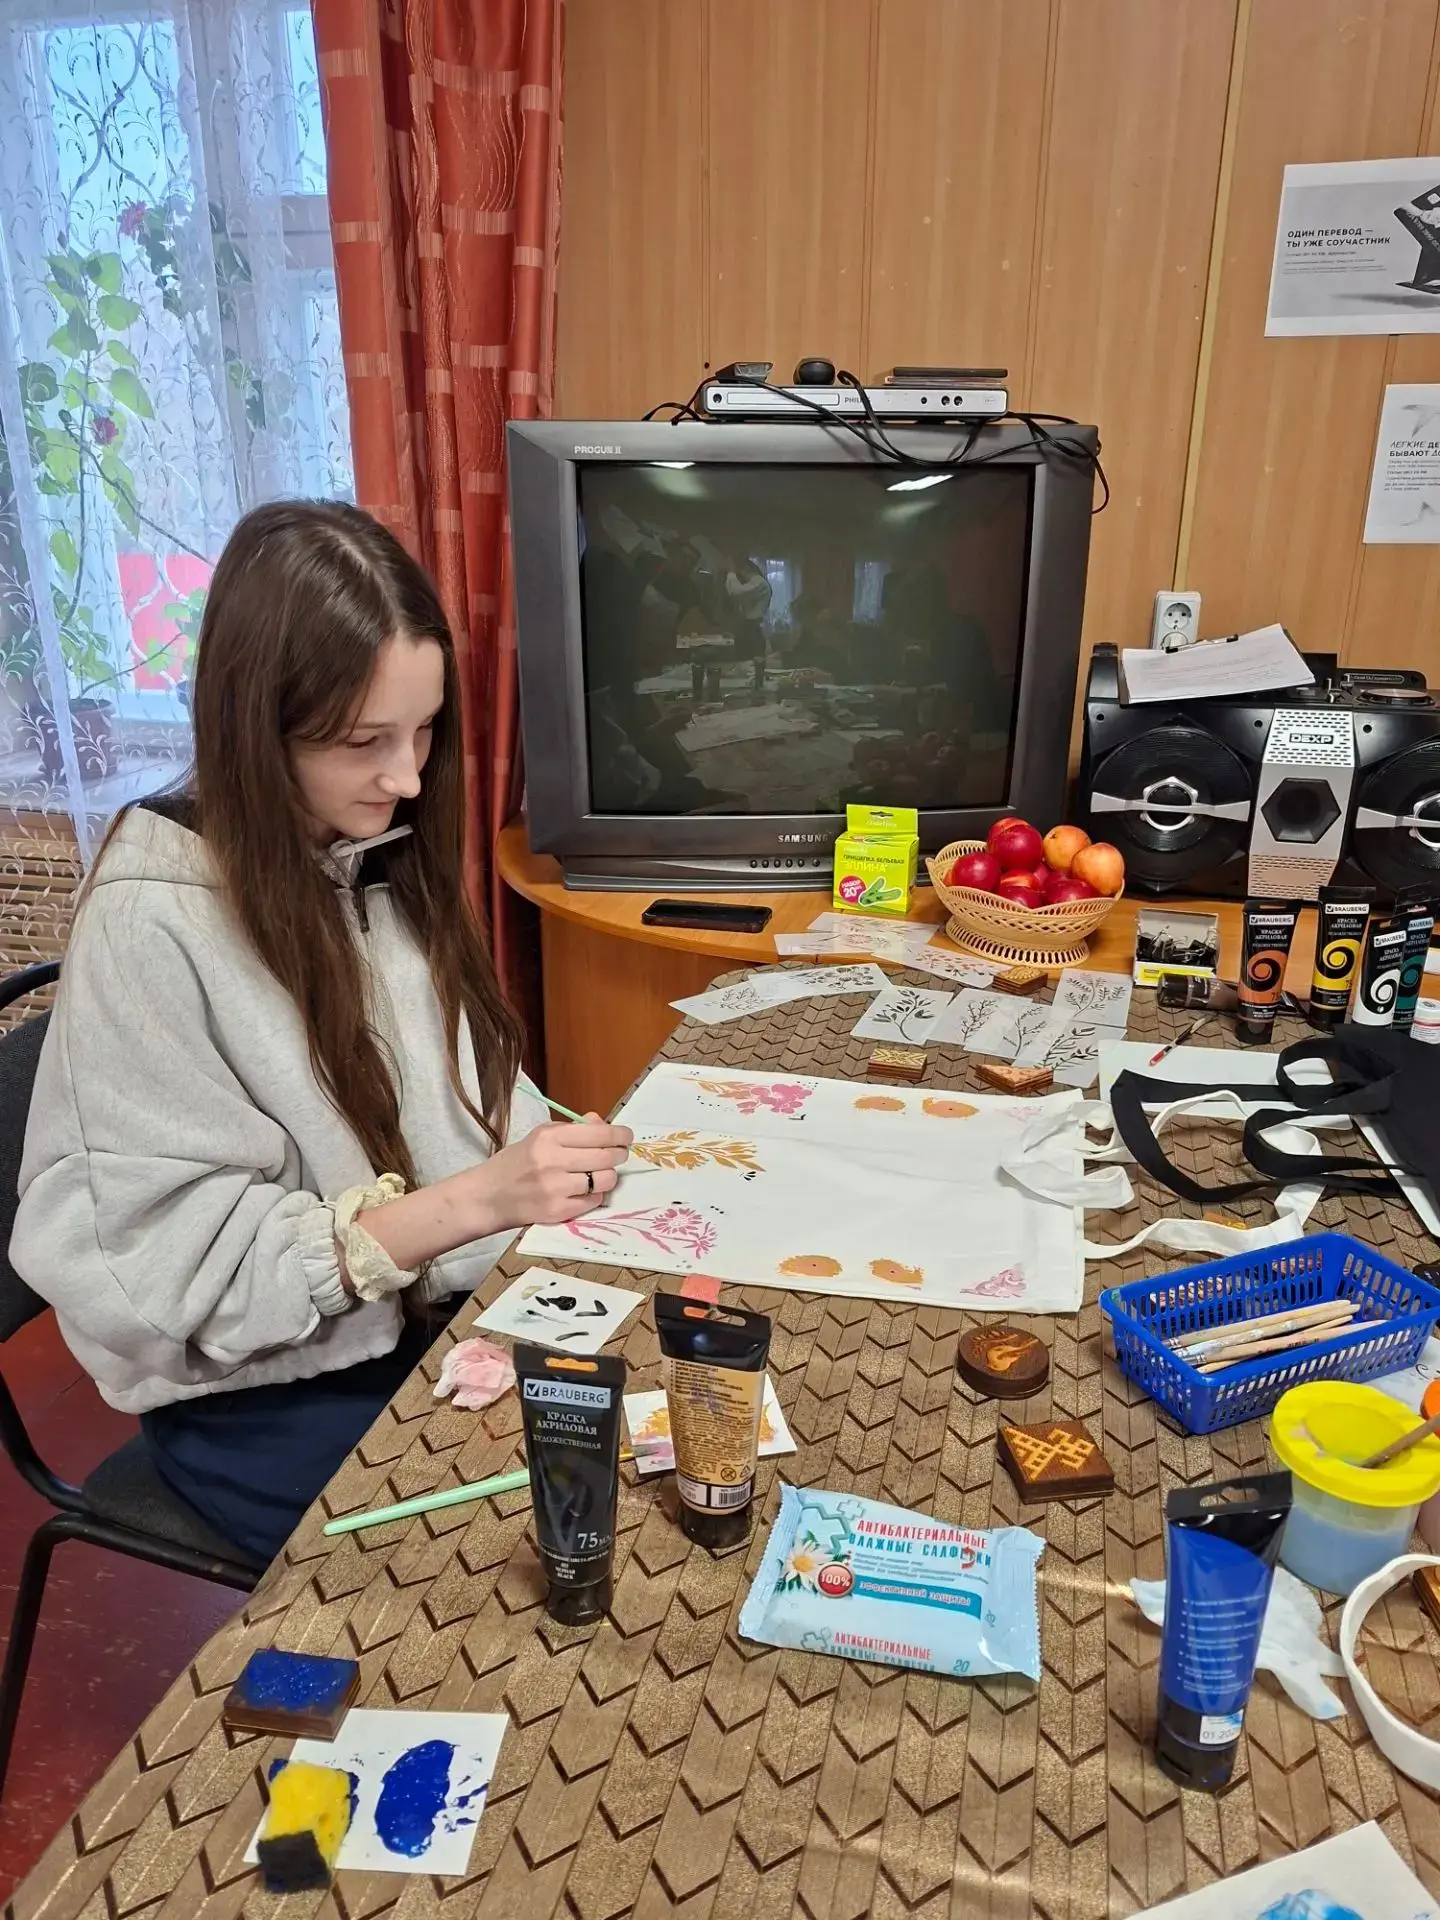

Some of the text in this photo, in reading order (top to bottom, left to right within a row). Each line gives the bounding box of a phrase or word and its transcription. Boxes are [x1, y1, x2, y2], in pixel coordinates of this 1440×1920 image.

[1287, 229, 1315, 239] ОДИН
[1317, 227, 1362, 237] ПЕРЕВОД
[1286, 236, 1391, 248] ТЫ УЖЕ СОУЧАСТНИК
[1289, 733, 1334, 744] DEXP
[1257, 916, 1292, 924] BRAUBERG
[1381, 934, 1405, 944] BRAUBERG
[541, 1386, 605, 1405] BRAUBERG
[546, 1411, 587, 1425] КРАСКА
[535, 1420, 598, 1436] АКРИЛОВАЯ
[532, 1434, 602, 1450] ХУДОЖЕСТВЕННАЯ
[857, 1519, 988, 1549] АНТИБАКТЕРИАЛЬНЫЕ
[848, 1533, 913, 1554] ВЛАЖНЫЕ
[821, 1572, 850, 1588] 100%
[834, 1631, 933, 1661] АНТИБАКТЕРИАЛЬНЫЕ
[953, 1658, 970, 1673] 20
